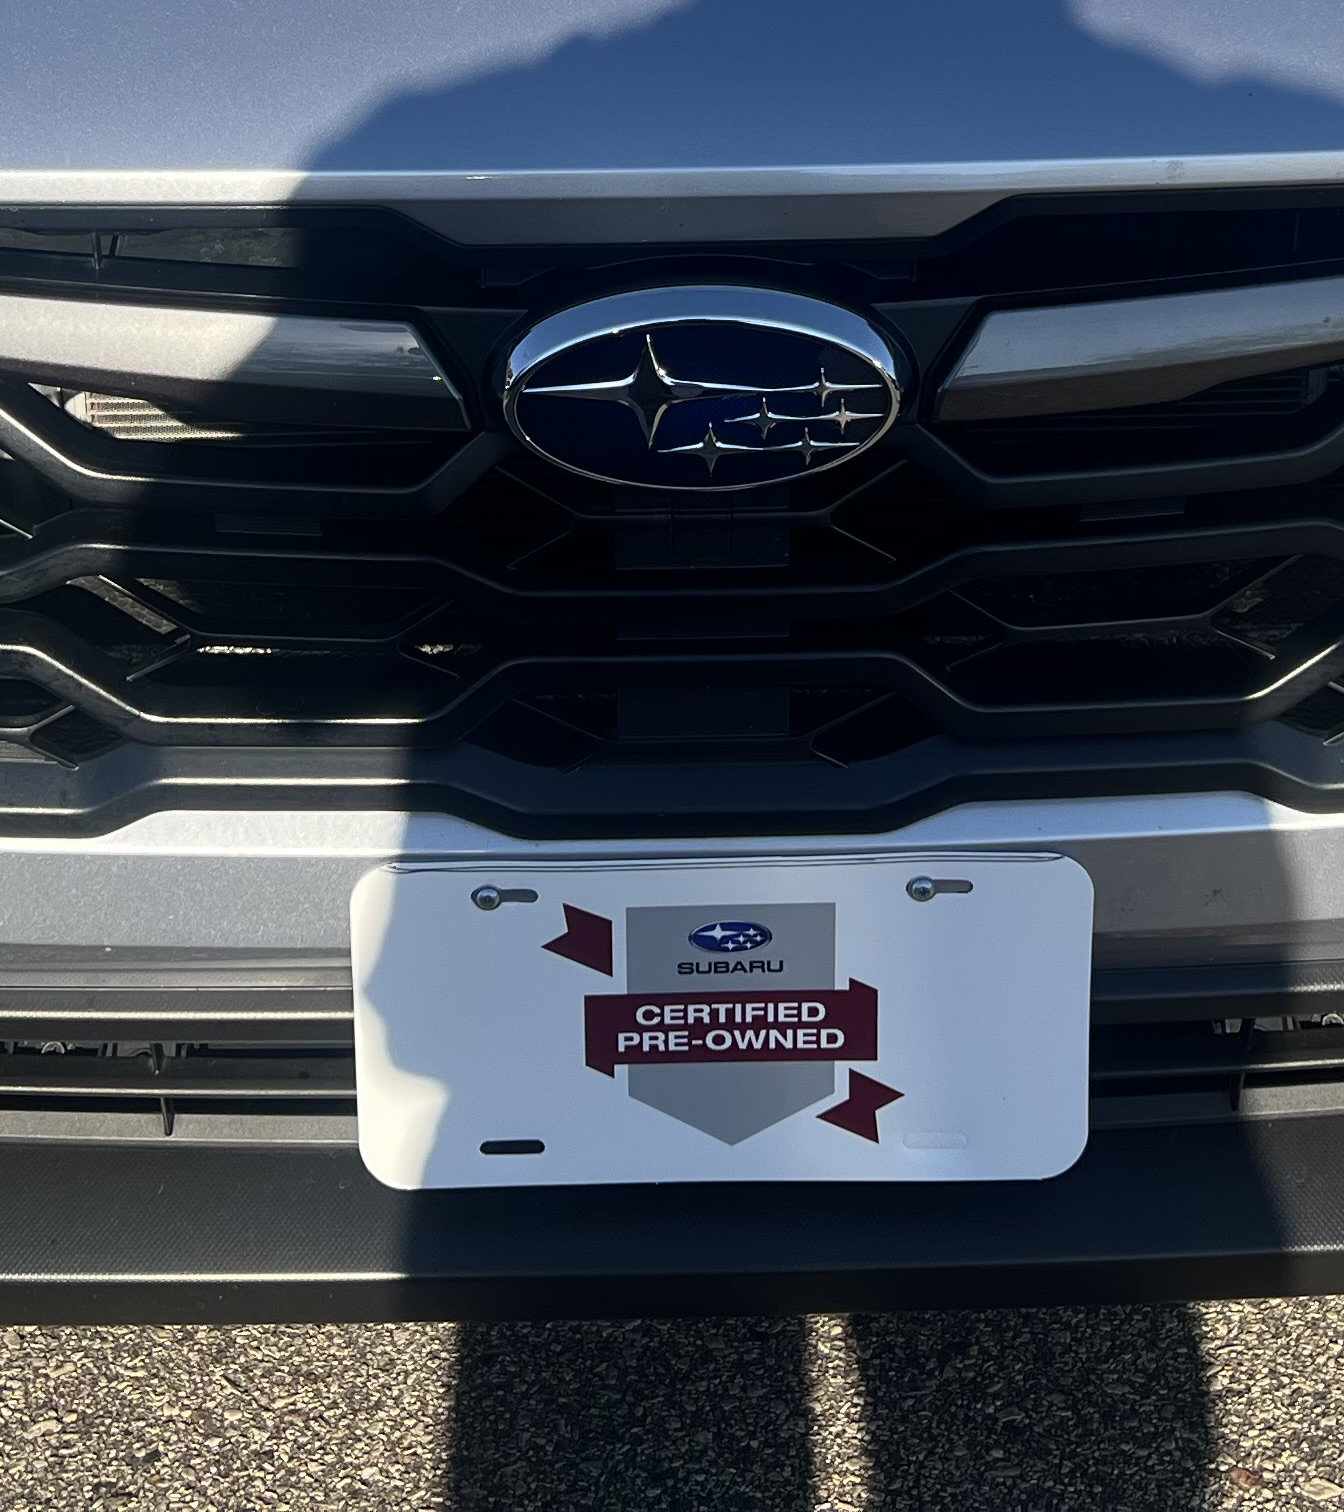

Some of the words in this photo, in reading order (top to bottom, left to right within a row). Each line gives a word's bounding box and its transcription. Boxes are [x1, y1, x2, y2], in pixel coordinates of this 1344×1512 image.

[677, 960, 784, 975] SUBARU
[635, 1002, 826, 1025] CERTIFIED
[617, 1028, 845, 1052] PRE-OWNED
